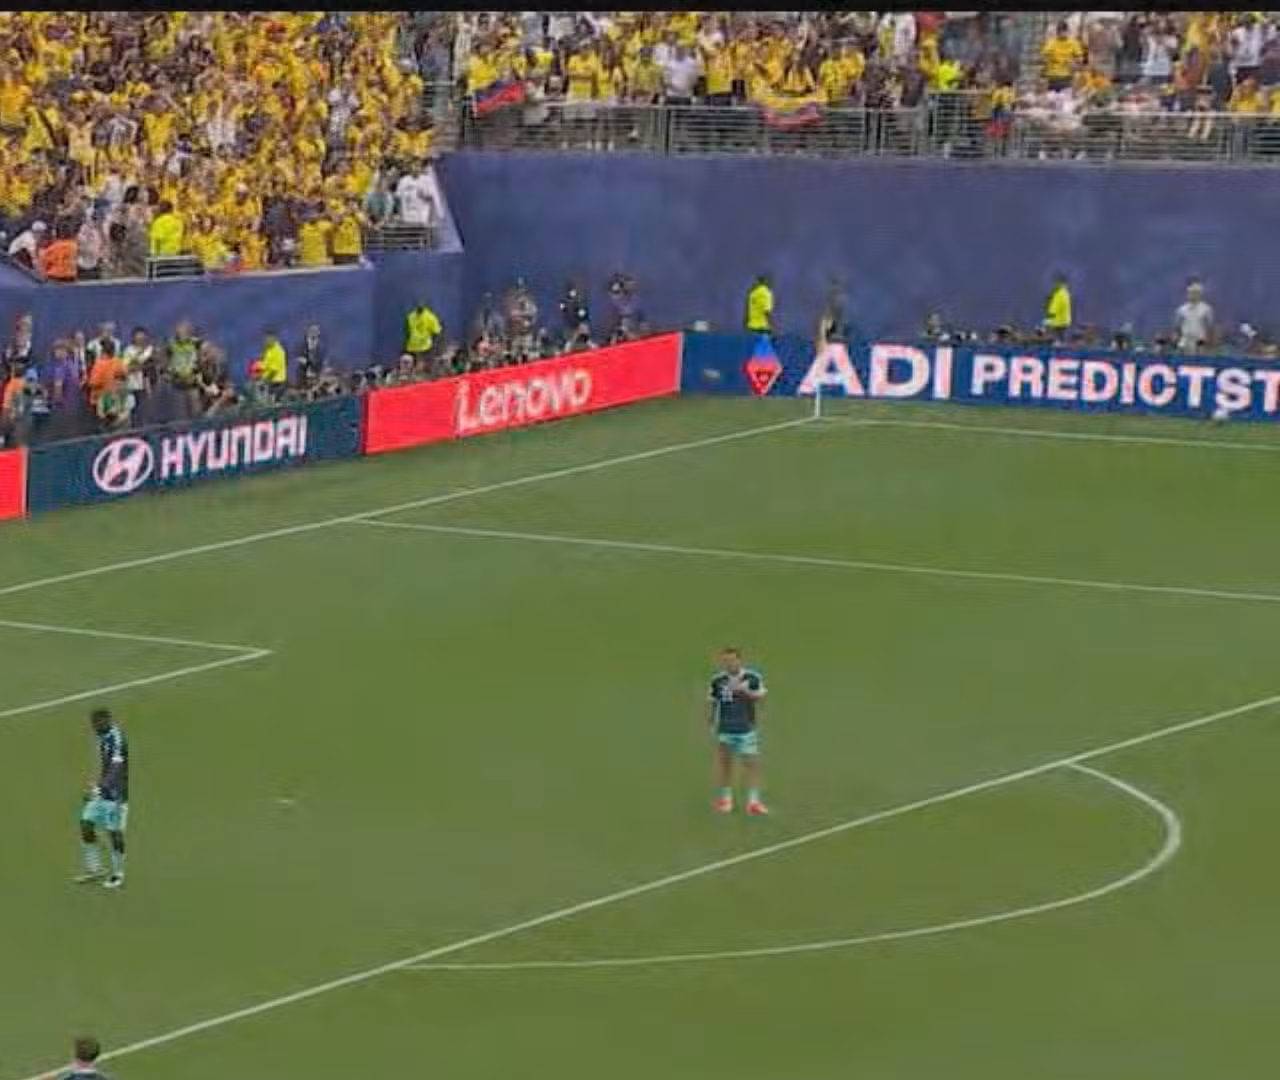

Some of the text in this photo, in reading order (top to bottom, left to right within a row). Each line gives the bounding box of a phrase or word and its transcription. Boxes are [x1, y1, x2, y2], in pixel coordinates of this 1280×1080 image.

[455, 369, 591, 434] Lenovo
[800, 342, 953, 399] ADI
[161, 416, 308, 478] HYUNDAI
